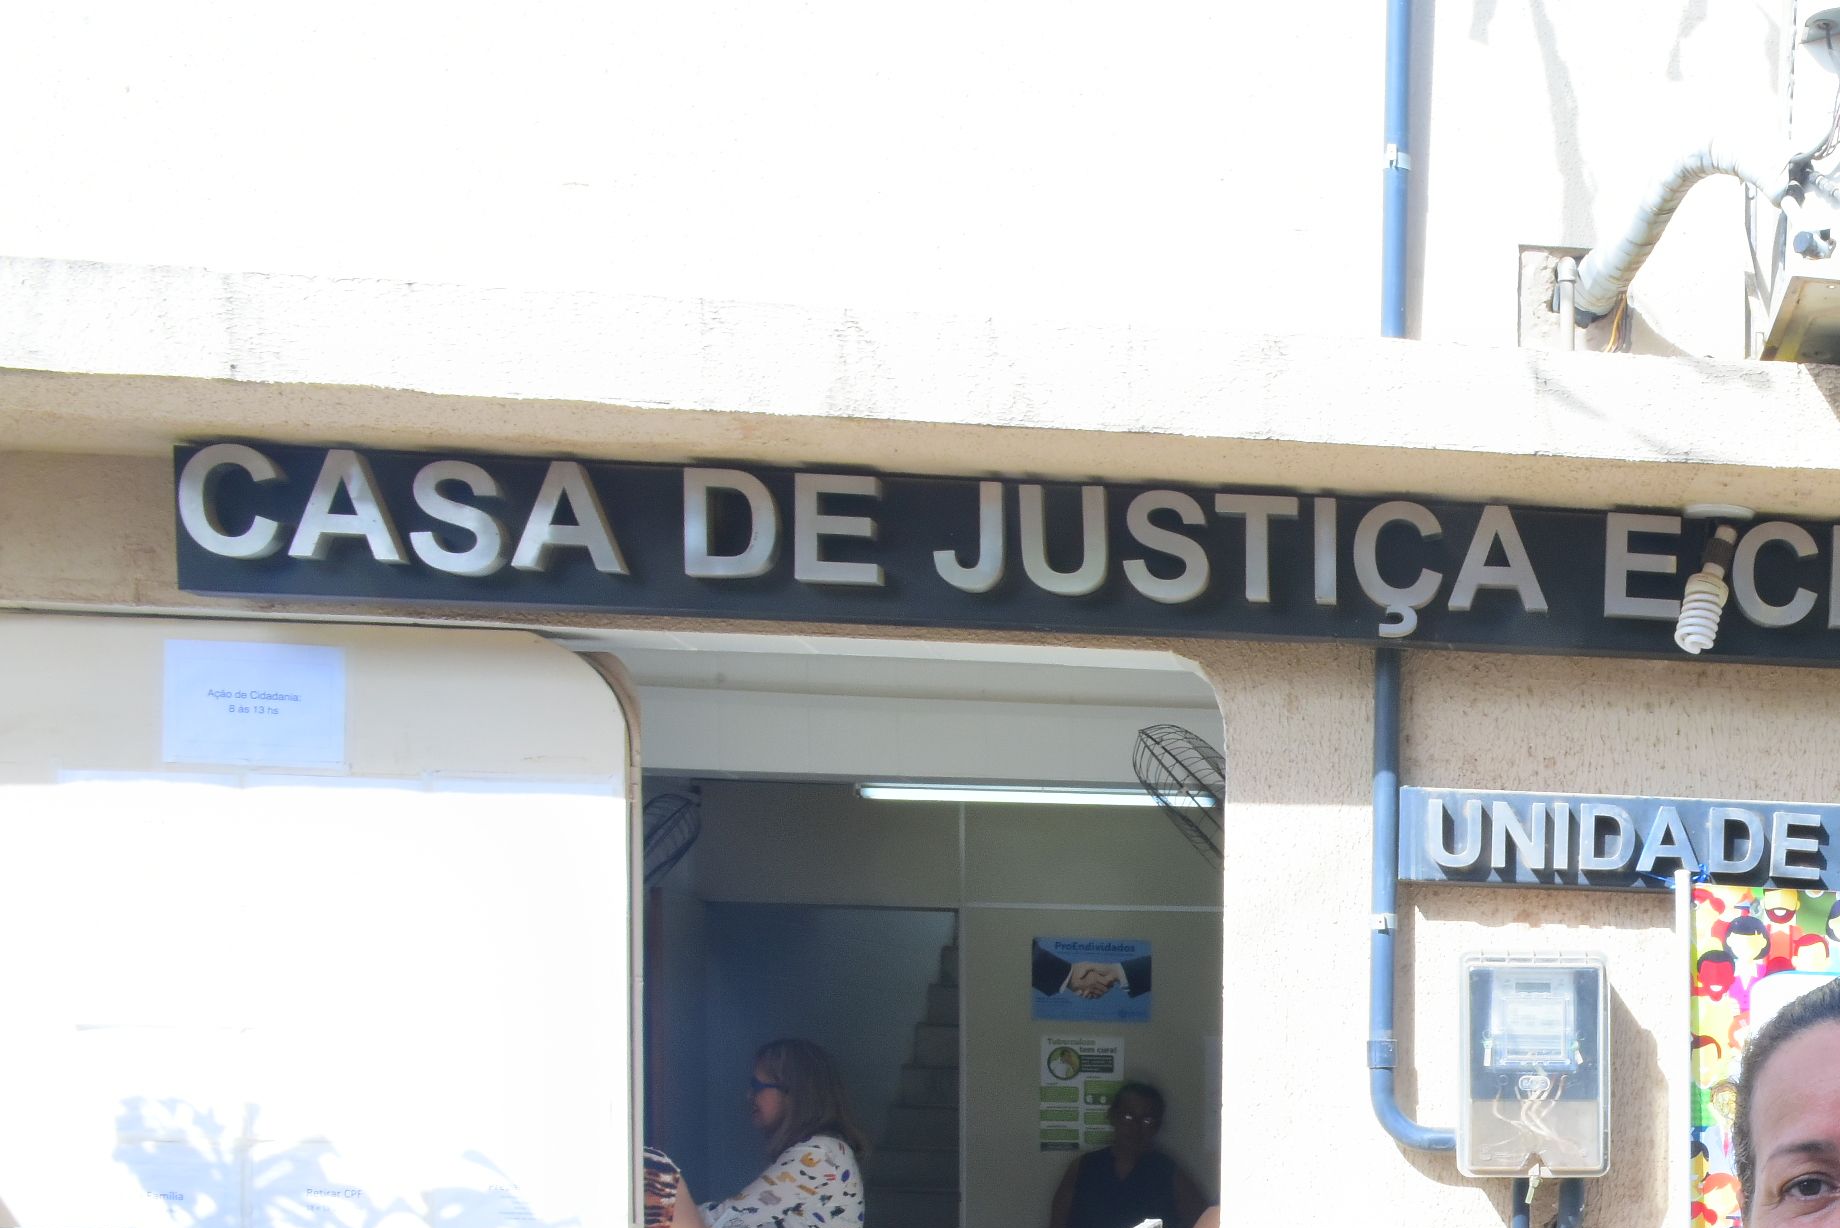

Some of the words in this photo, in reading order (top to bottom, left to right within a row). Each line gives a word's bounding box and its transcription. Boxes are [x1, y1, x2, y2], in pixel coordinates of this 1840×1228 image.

[178, 443, 628, 577] CASA
[684, 468, 885, 587] DE
[933, 481, 1549, 639] JUSTIÇA
[1604, 511, 1682, 621] E
[208, 689, 232, 700] Ação
[235, 690, 247, 699] de
[1426, 798, 1821, 881] UNIDADE
[1054, 941, 1136, 953] ProEndividados
